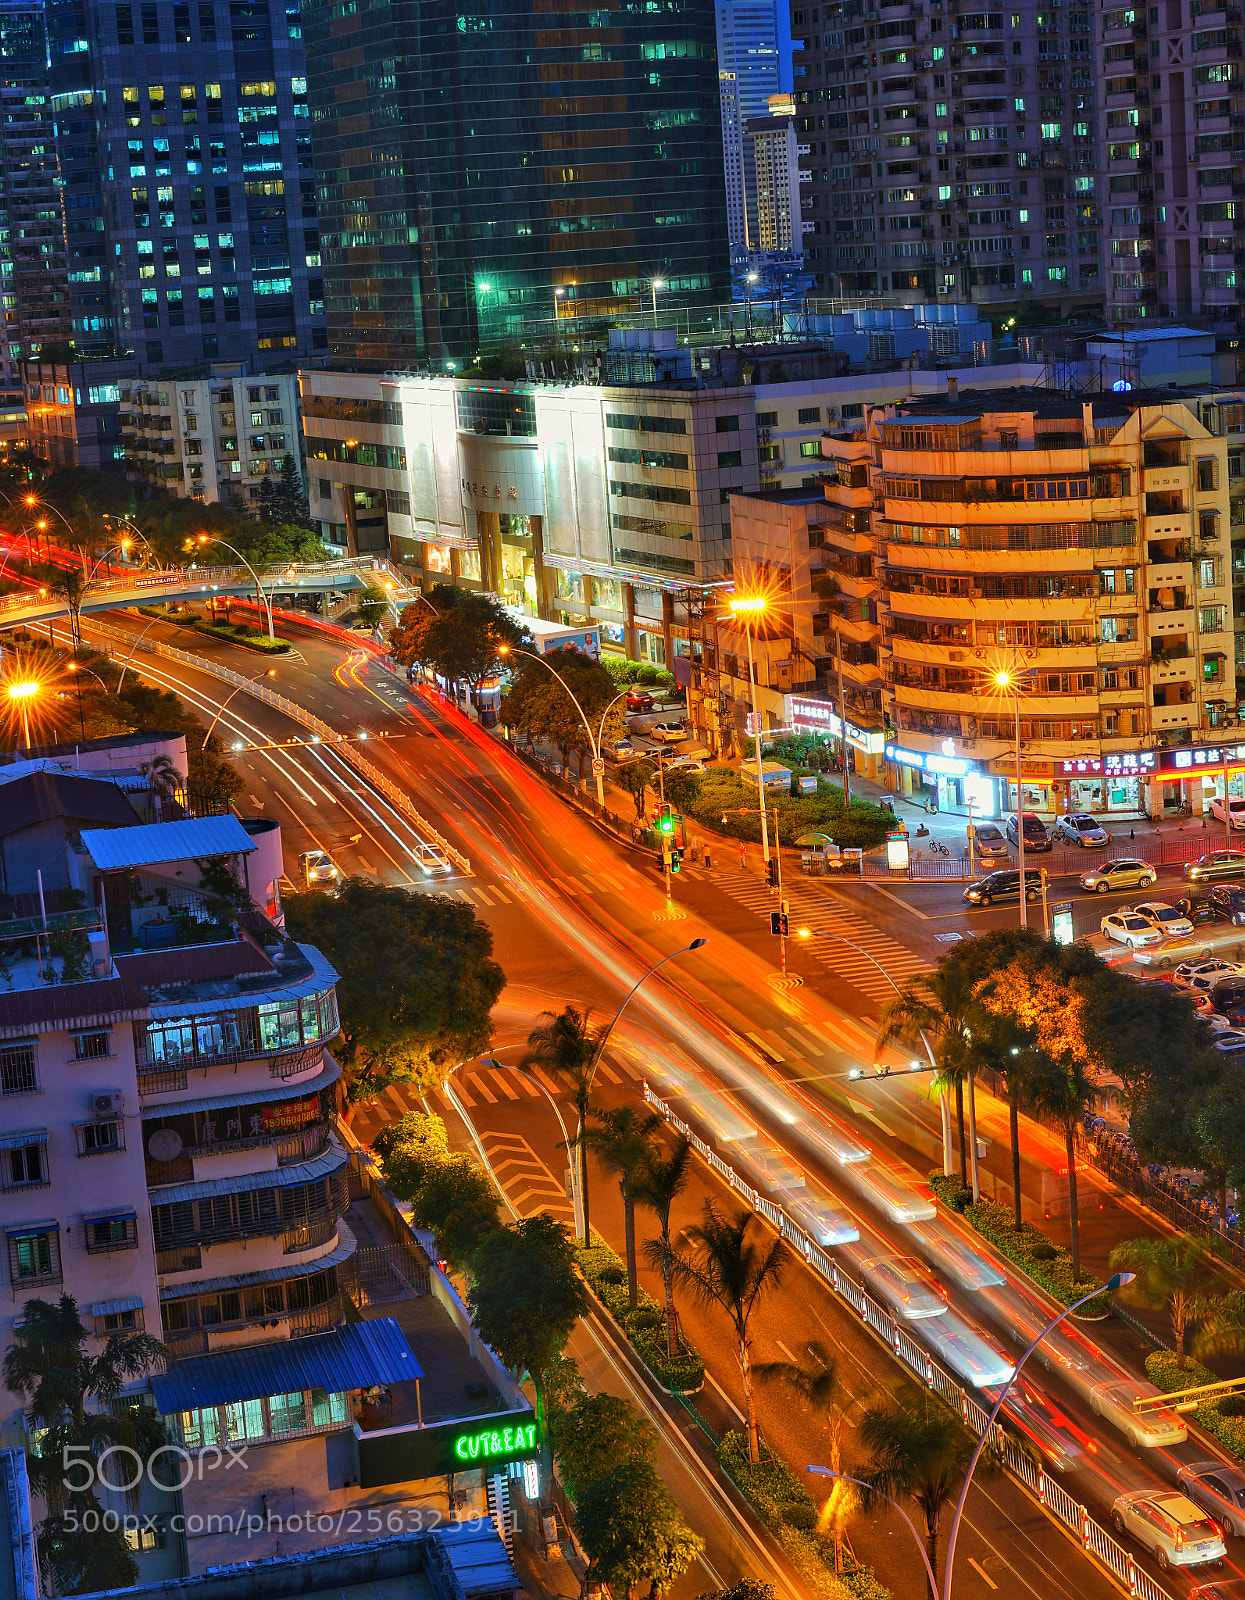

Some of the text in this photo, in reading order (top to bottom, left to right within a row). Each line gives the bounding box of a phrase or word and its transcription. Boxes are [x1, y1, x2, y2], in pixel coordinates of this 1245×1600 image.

[1106, 752, 1155, 769] 洗鞋吧
[1105, 767, 1148, 776] 奢侈品护理
[458, 1425, 535, 1457] CUT&EAT
